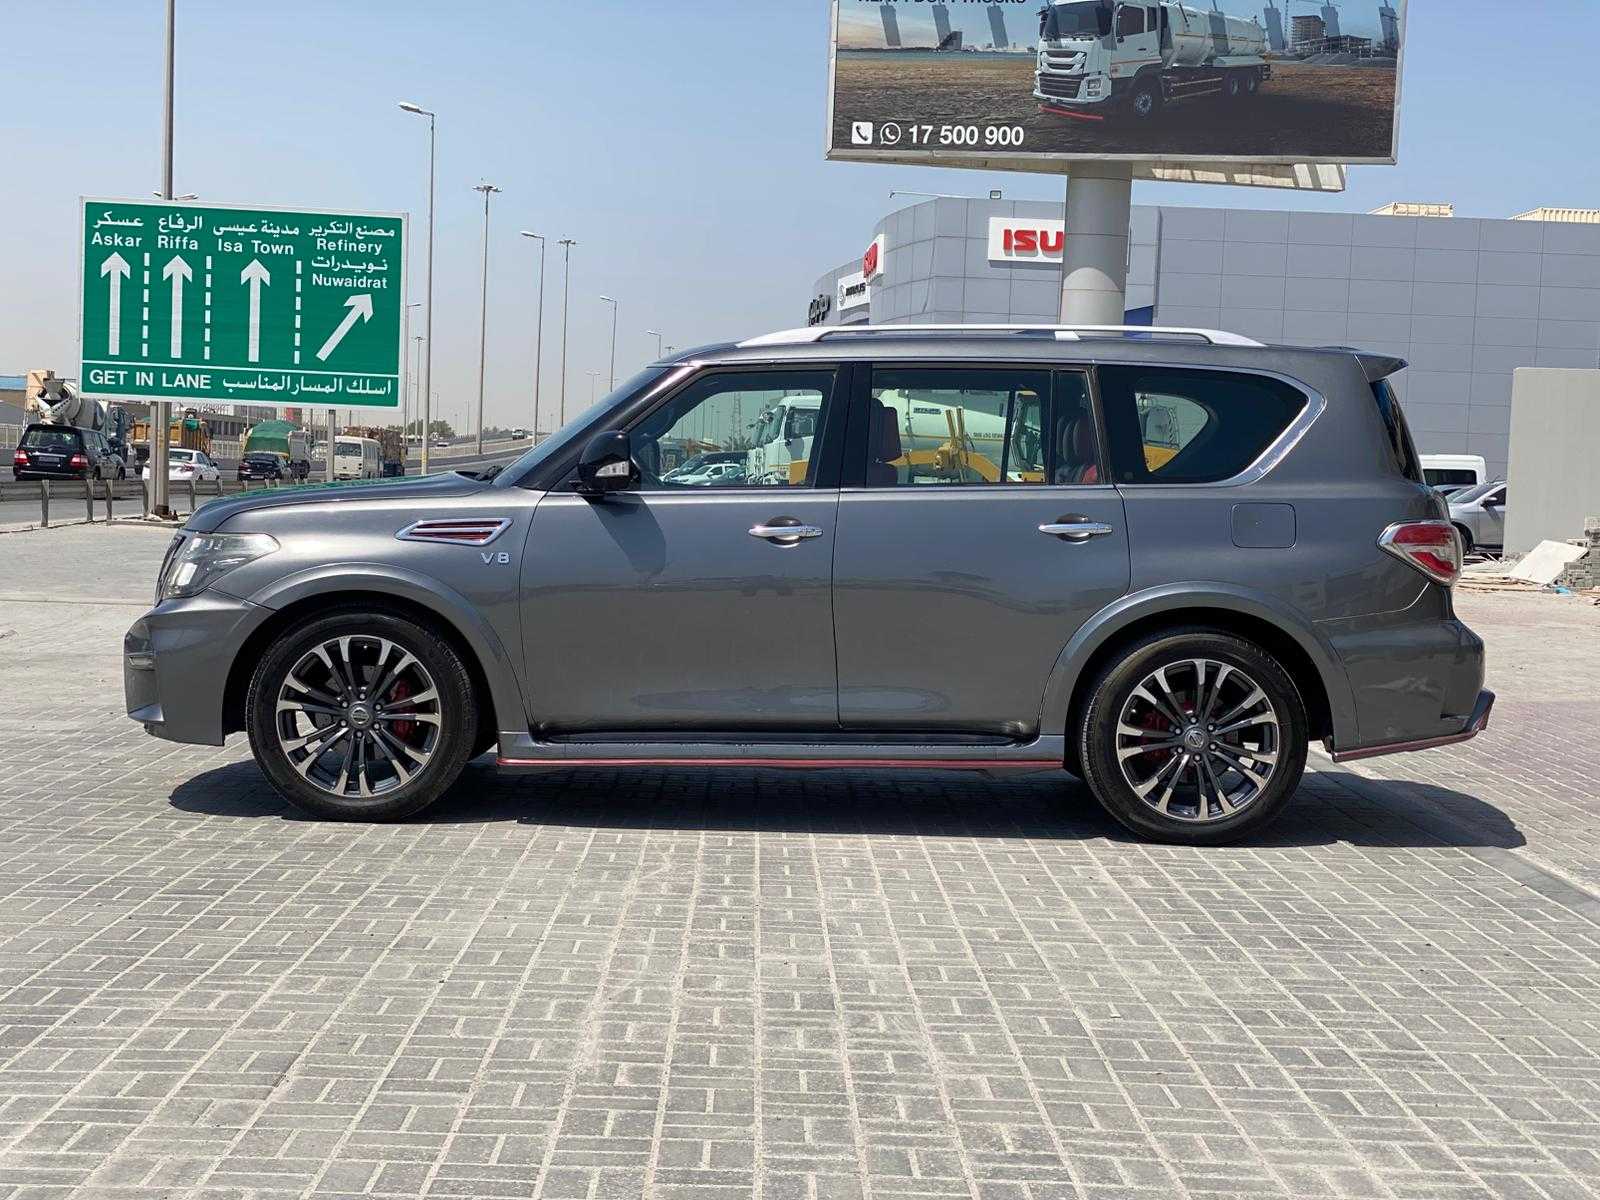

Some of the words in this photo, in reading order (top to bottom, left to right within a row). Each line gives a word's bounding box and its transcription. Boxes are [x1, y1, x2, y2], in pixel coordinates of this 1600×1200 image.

[908, 125, 933, 144] 17
[939, 125, 979, 145] 500
[984, 125, 1024, 146] 900
[92, 211, 144, 228] عسكر
[158, 213, 203, 233] الرفاع
[212, 222, 258, 236] عيسى
[260, 220, 300, 237] مدينة
[308, 220, 353, 237] التكرير
[355, 226, 396, 239] مصنع
[91, 231, 142, 247] Askar
[157, 235, 199, 250] Riffa
[217, 238, 243, 253] Isa
[250, 239, 294, 255] Town
[316, 237, 382, 256] Refinery
[311, 255, 388, 273] نويدرات
[312, 273, 388, 289] Nuwaidrat
[89, 369, 128, 385] GET
[135, 371, 154, 387] IN
[161, 373, 212, 389] LANE
[347, 379, 392, 395] اسلك
[480, 552, 510, 565] V8
